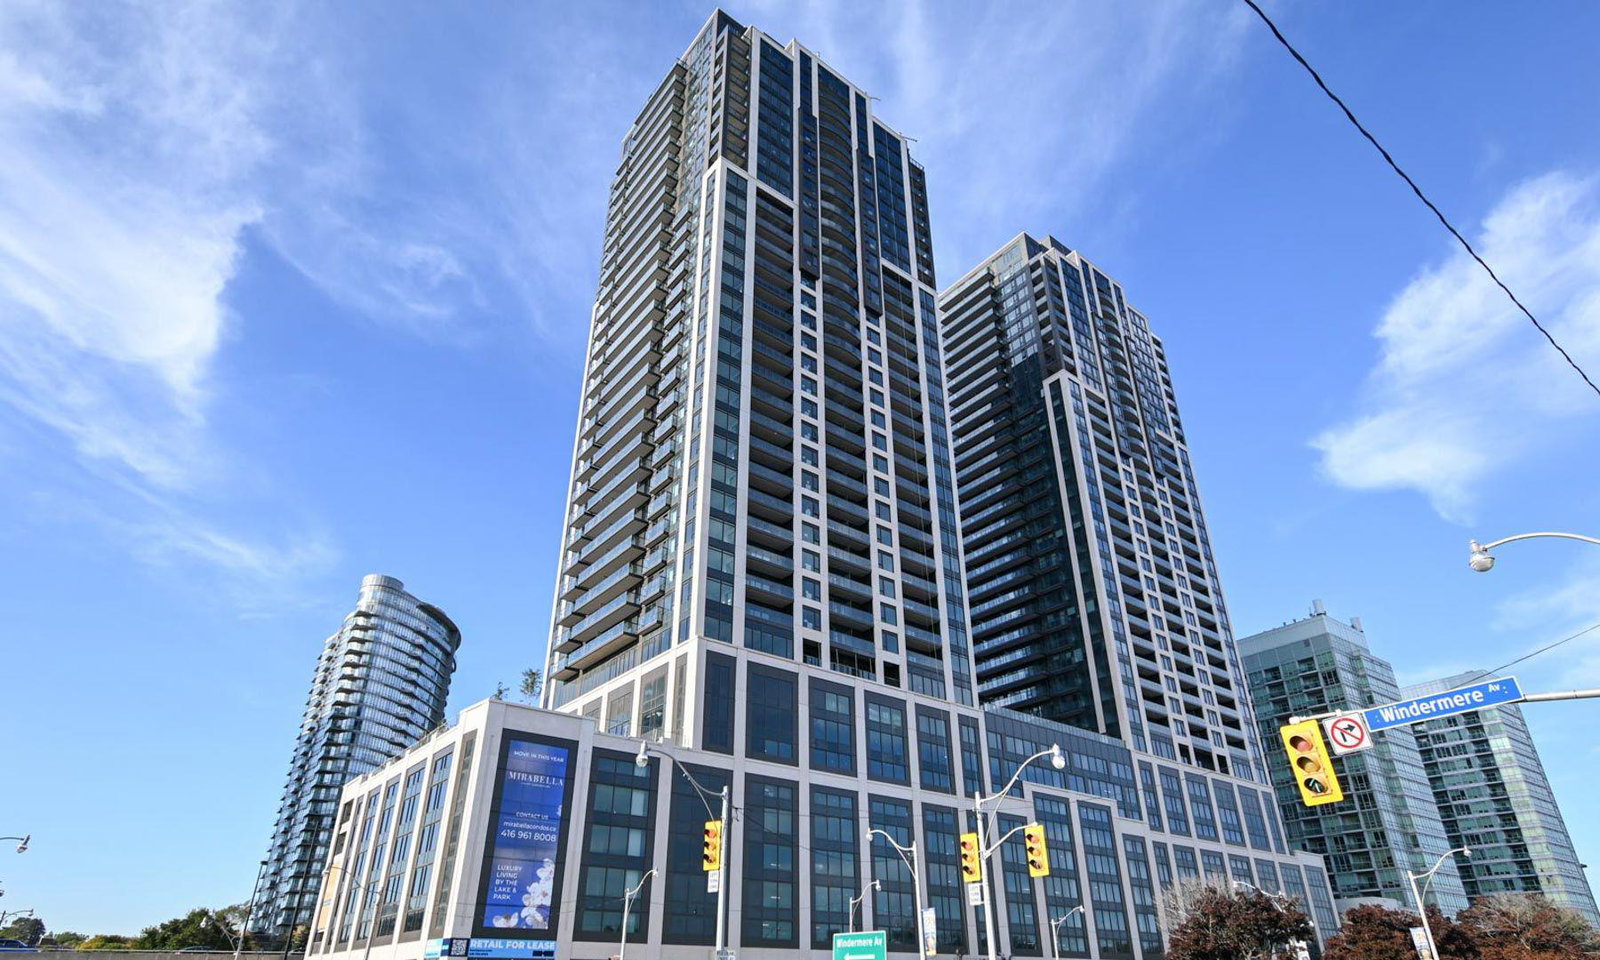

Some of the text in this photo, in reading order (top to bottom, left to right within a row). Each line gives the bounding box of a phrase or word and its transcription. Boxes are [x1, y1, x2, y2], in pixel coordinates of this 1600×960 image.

[1380, 684, 1500, 723] Windermere Av
[509, 771, 564, 786] MIRABELLA
[504, 820, 556, 832] mirabellacondos.ca
[501, 829, 556, 842] 416 961 8008
[470, 940, 556, 950] RETAIL FOR LEASE
[837, 938, 872, 948] Windermere
